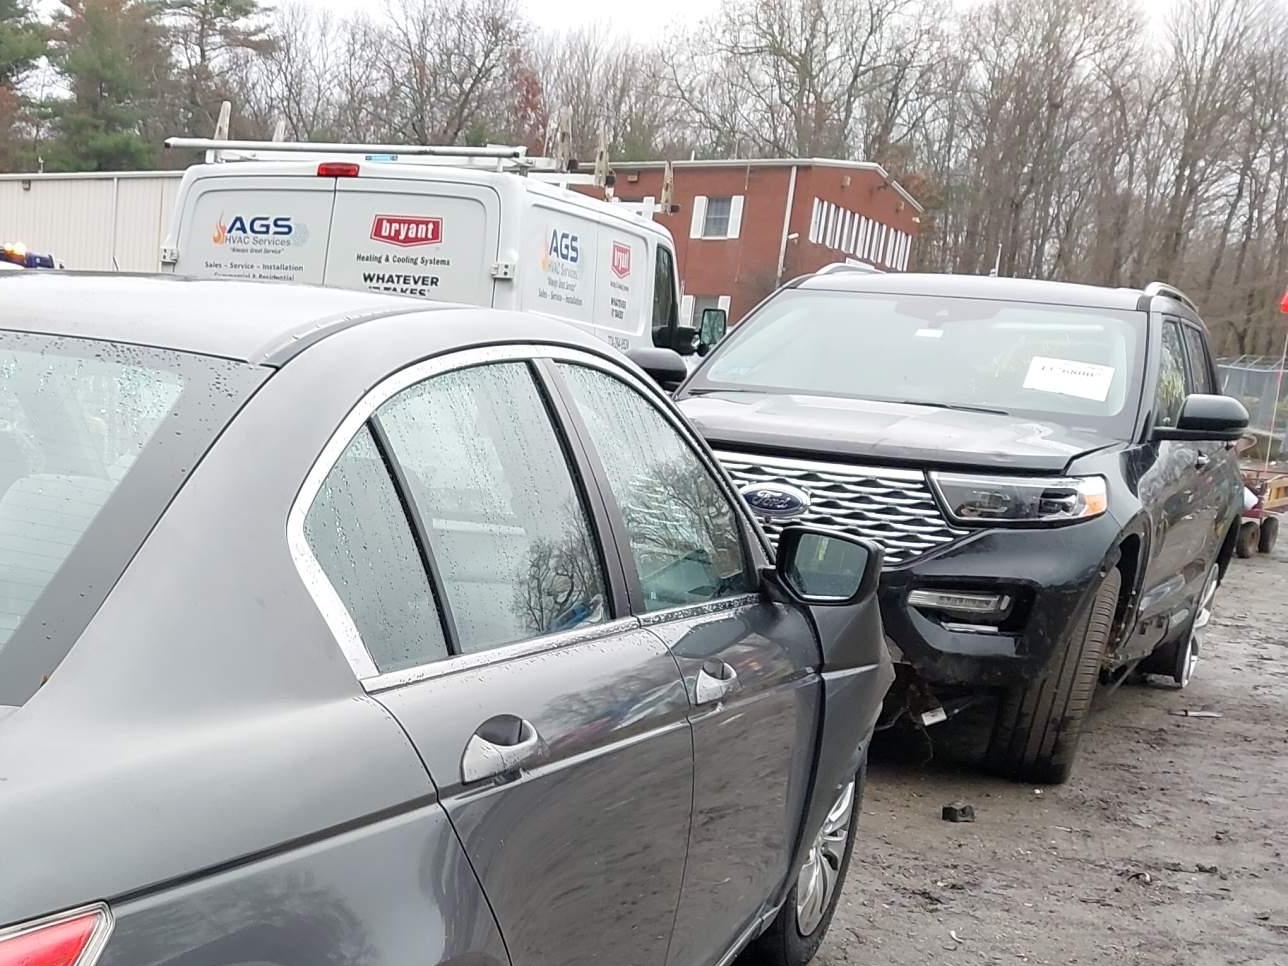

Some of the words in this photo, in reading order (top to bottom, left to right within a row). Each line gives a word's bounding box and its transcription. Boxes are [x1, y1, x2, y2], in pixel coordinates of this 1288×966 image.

[226, 216, 293, 235] AGS
[381, 219, 434, 240] bryant
[224, 236, 250, 245] HVAC
[252, 236, 291, 246] Services
[549, 229, 579, 263] AGS
[262, 263, 304, 271] Installation
[356, 253, 383, 264] Heating
[384, 254, 390, 263] &
[392, 255, 419, 266] Cooling
[420, 256, 450, 266] Systems
[363, 272, 440, 287] WHATEVER
[752, 490, 791, 509] Ford
